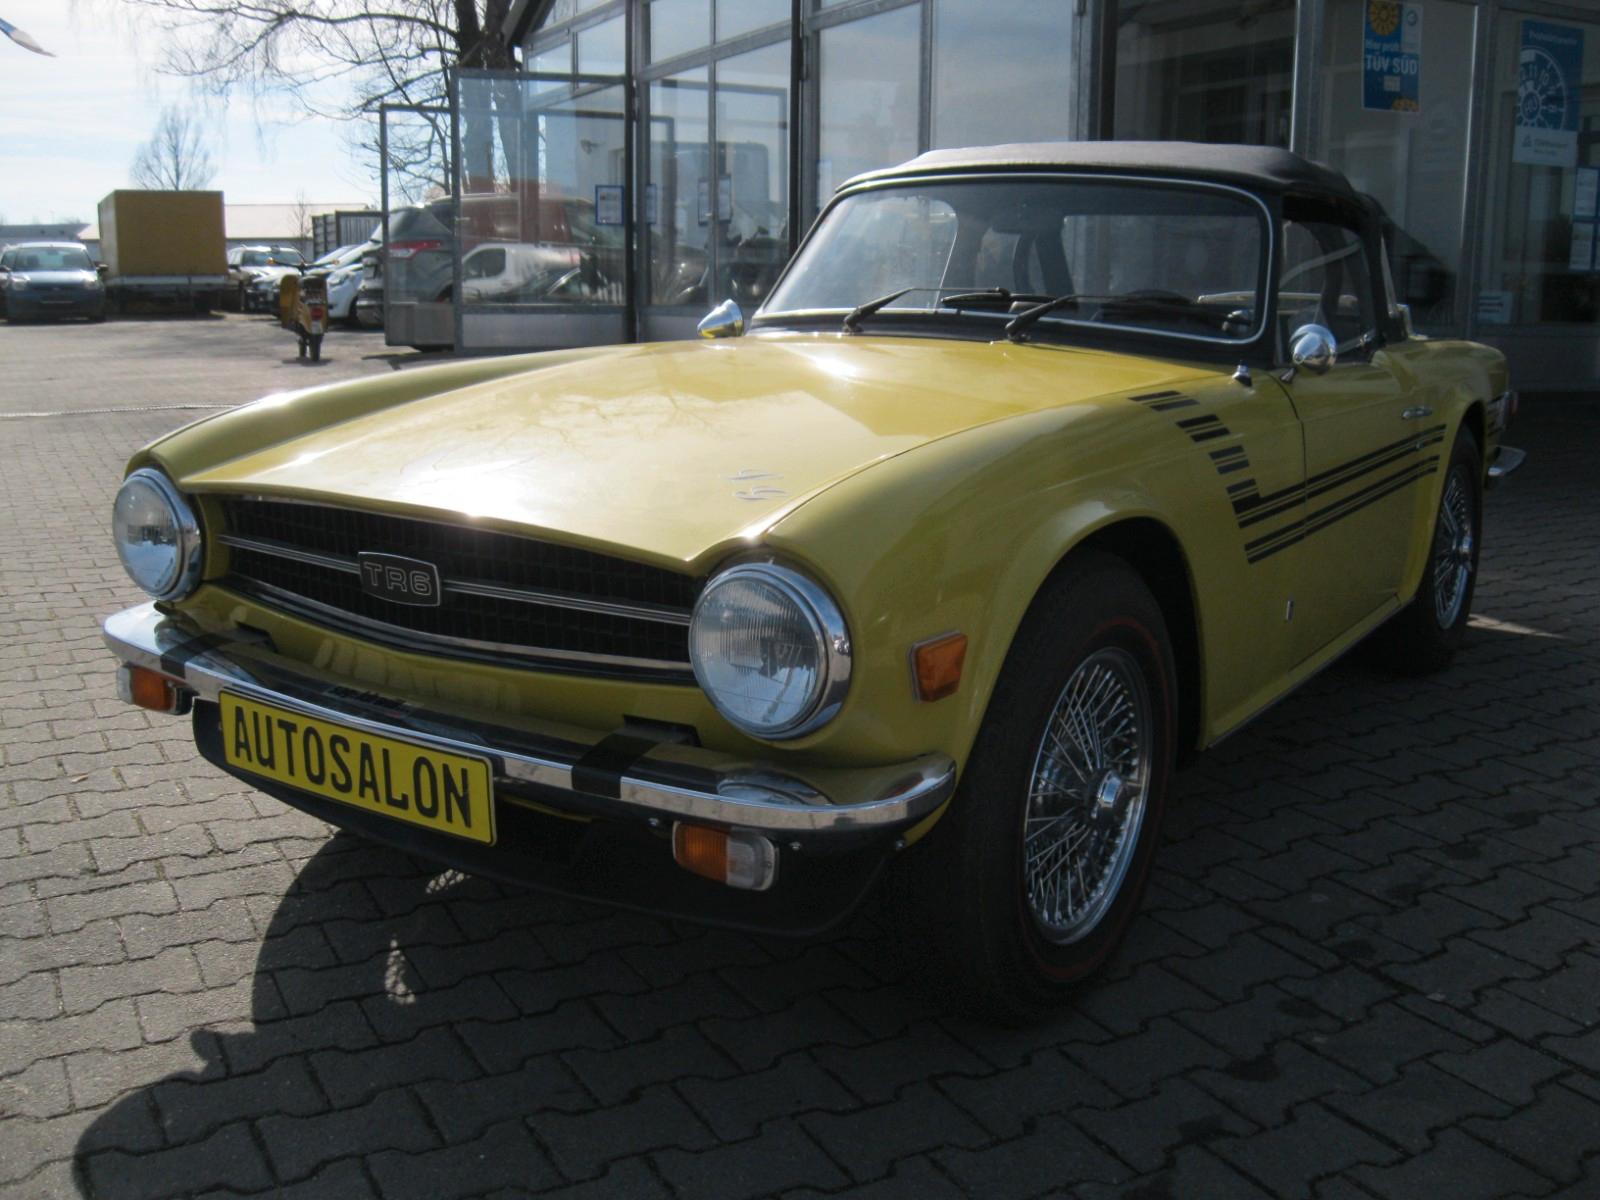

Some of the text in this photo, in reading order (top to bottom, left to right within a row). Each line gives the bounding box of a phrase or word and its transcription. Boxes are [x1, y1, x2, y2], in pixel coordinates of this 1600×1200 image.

[1366, 51, 1418, 75] TÜV SÜD
[363, 561, 432, 596] TR6
[233, 705, 473, 829] AUTOSALON
